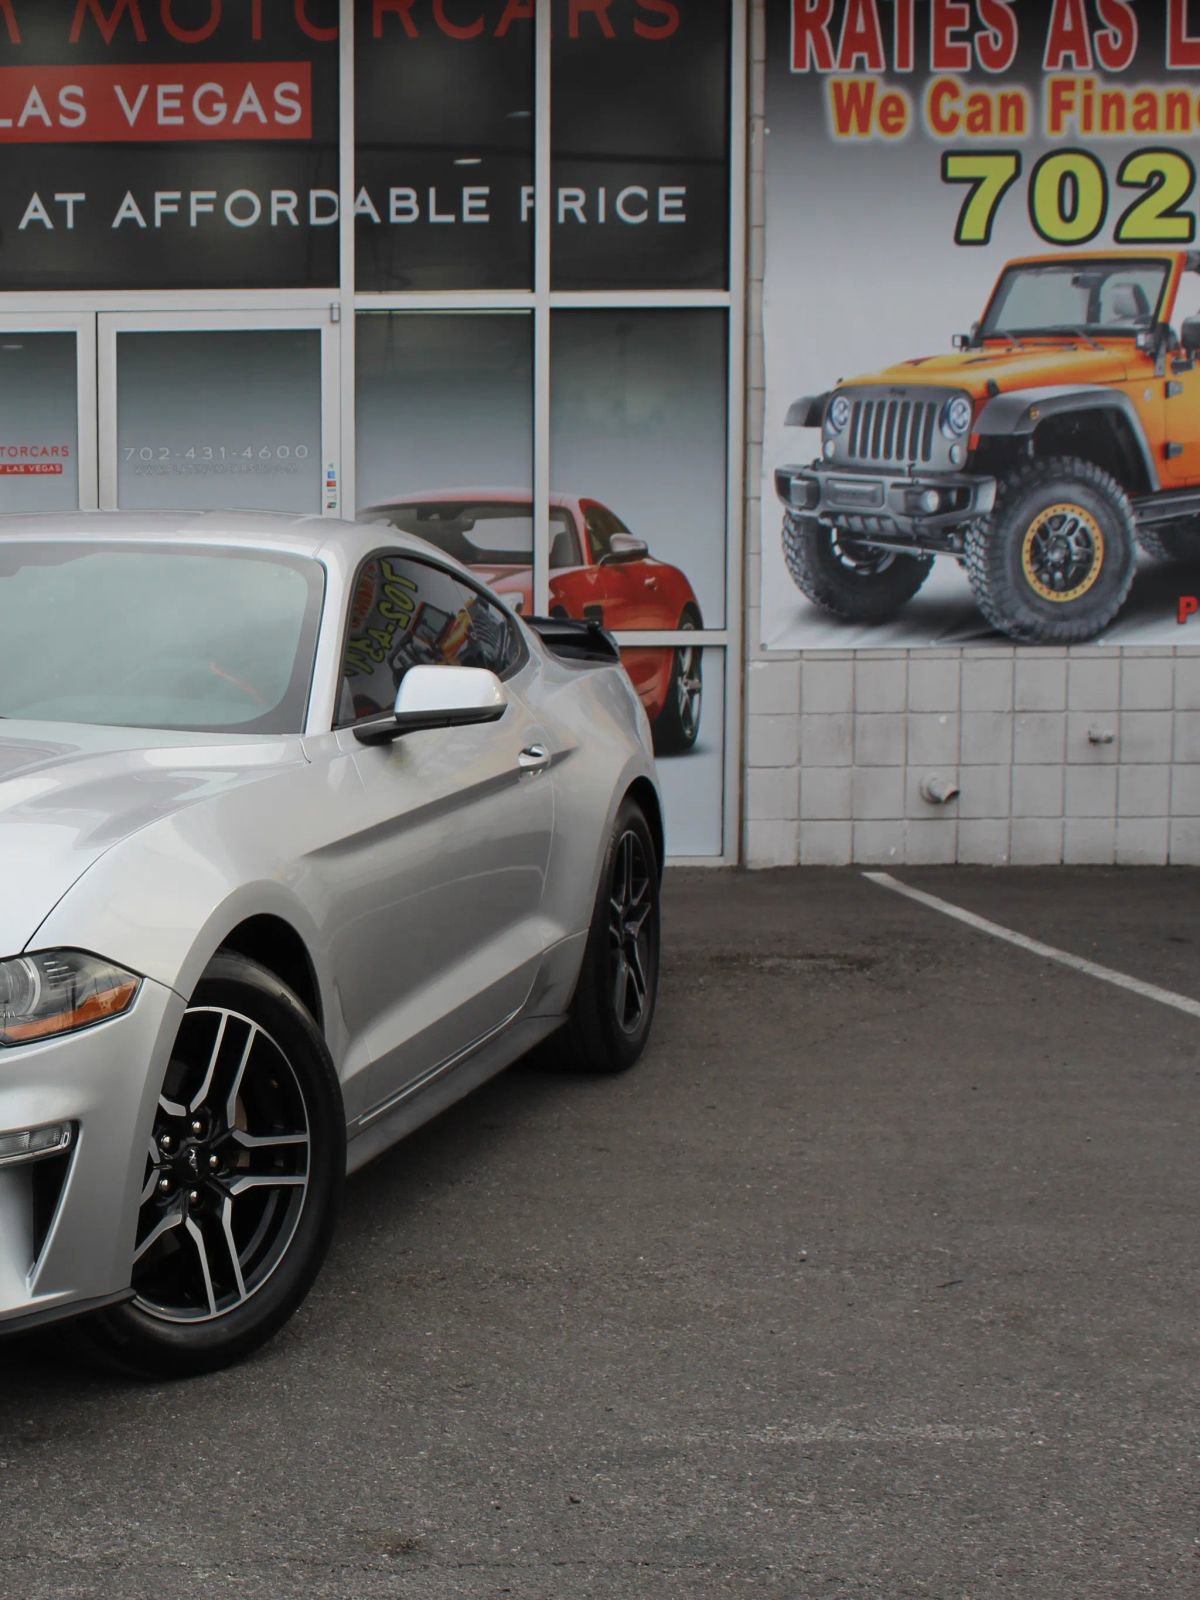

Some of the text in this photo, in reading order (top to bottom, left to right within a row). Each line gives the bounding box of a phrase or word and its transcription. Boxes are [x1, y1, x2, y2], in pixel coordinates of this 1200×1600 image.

[1042, 0, 1138, 72] AS
[113, 80, 302, 127] VEGAS
[831, 77, 1200, 137] We Can Finan
[18, 191, 85, 230] AT
[112, 185, 490, 228] AFFORDABLE
[941, 147, 1196, 246] 702
[6, 464, 25, 472] LAS
[28, 464, 62, 472] VEGAS
[123, 444, 310, 461] 702-431-4600
